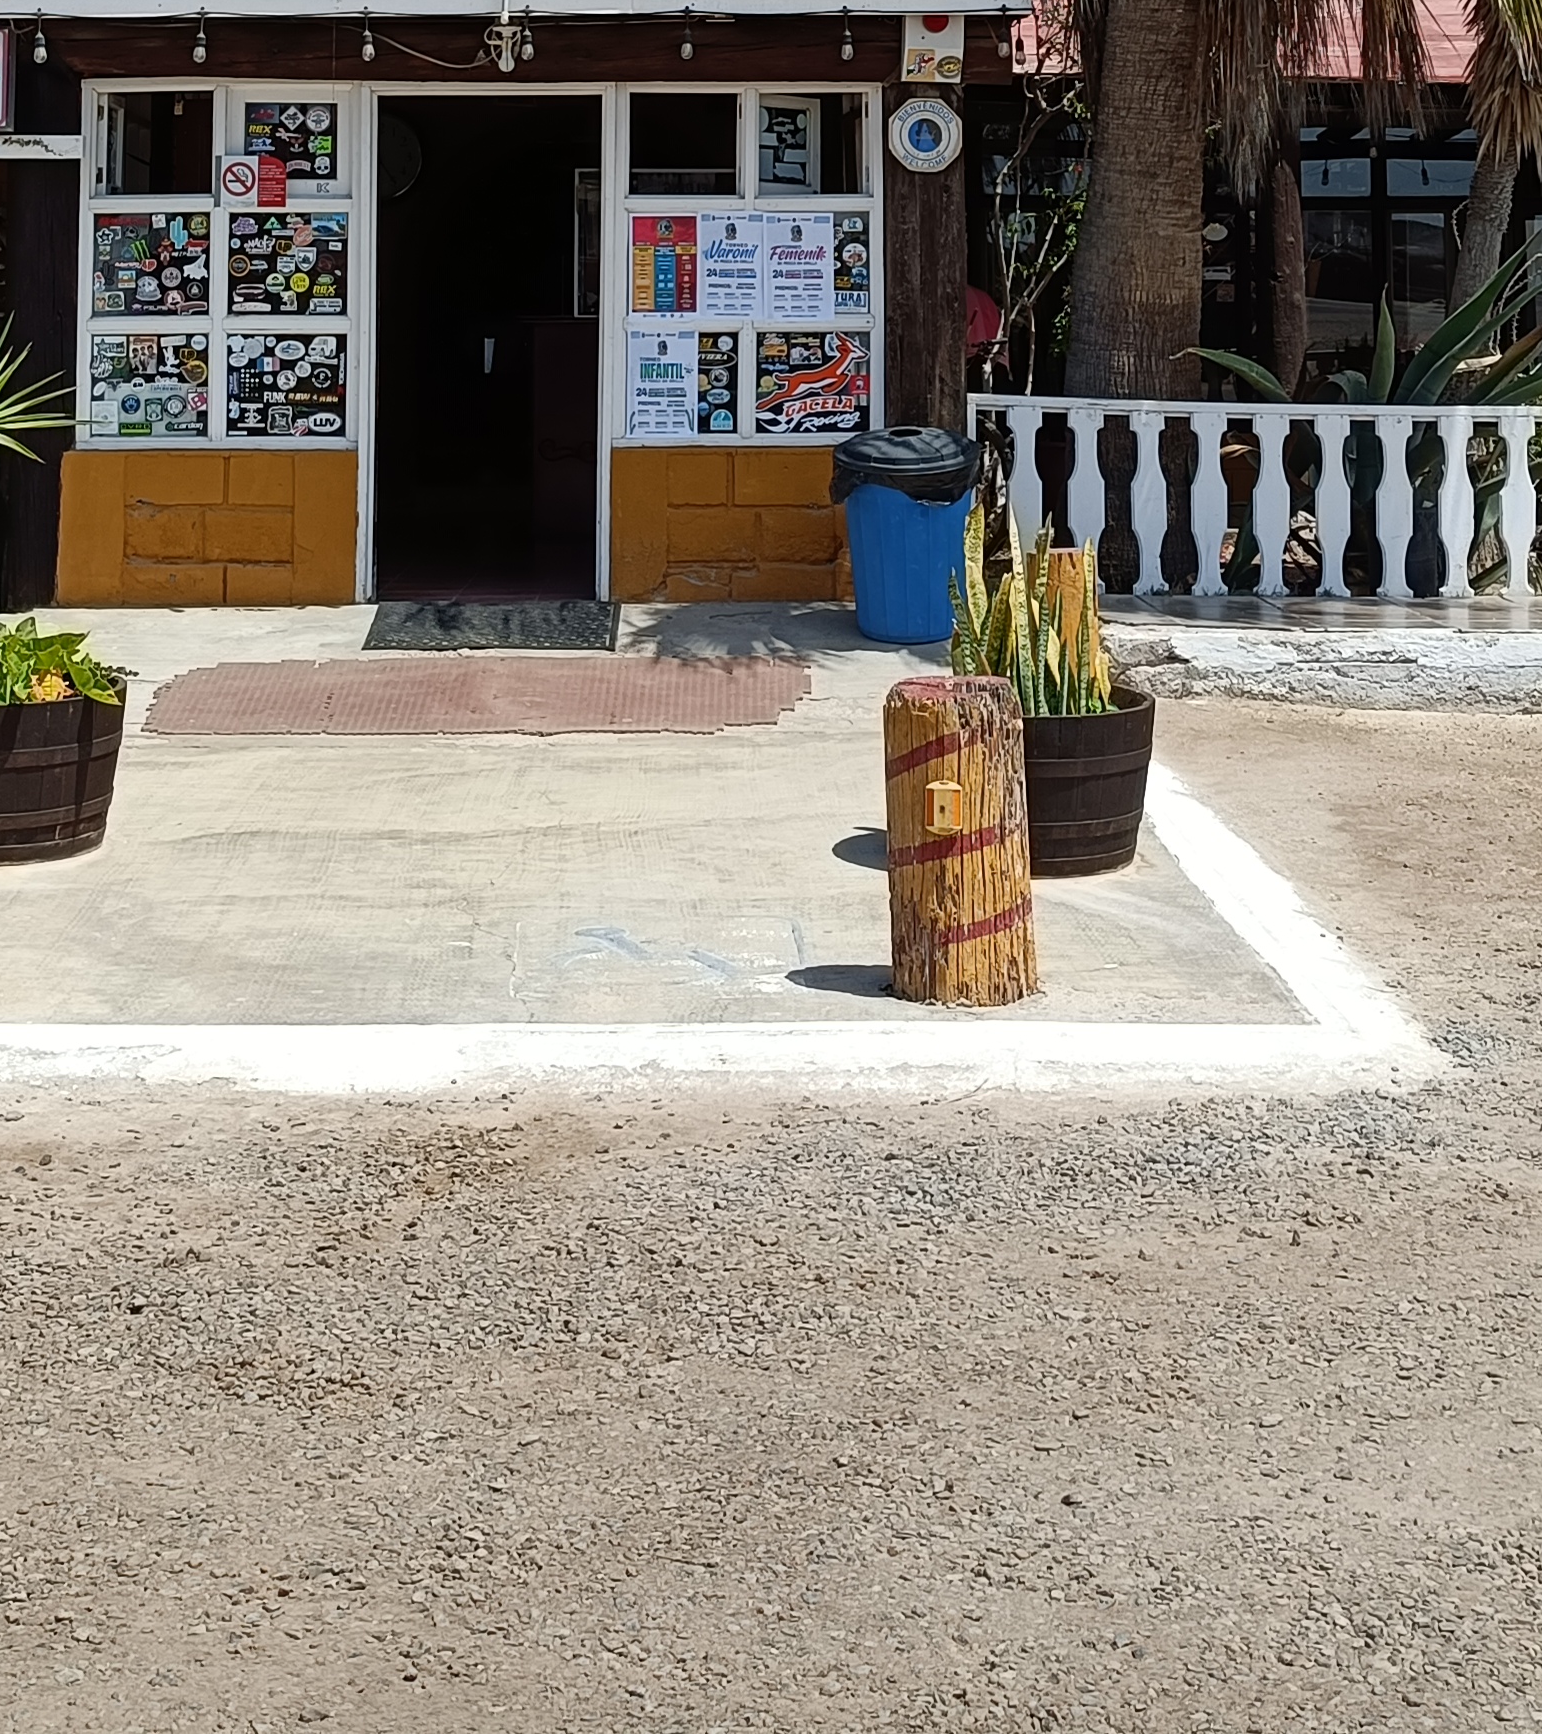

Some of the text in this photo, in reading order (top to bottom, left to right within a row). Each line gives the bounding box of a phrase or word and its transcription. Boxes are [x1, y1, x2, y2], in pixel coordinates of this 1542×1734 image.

[897, 101, 955, 125] BIENVENIDOS
[709, 239, 759, 260] Varonil
[770, 245, 824, 261] Femenil
[706, 268, 718, 278] 24
[772, 269, 784, 279] 24
[640, 363, 685, 379] INFANTIL
[263, 391, 287, 403] FUNK
[635, 387, 648, 397] 24
[784, 397, 854, 418] GACELA
[313, 418, 336, 427] LUV
[800, 412, 861, 432] Racing
